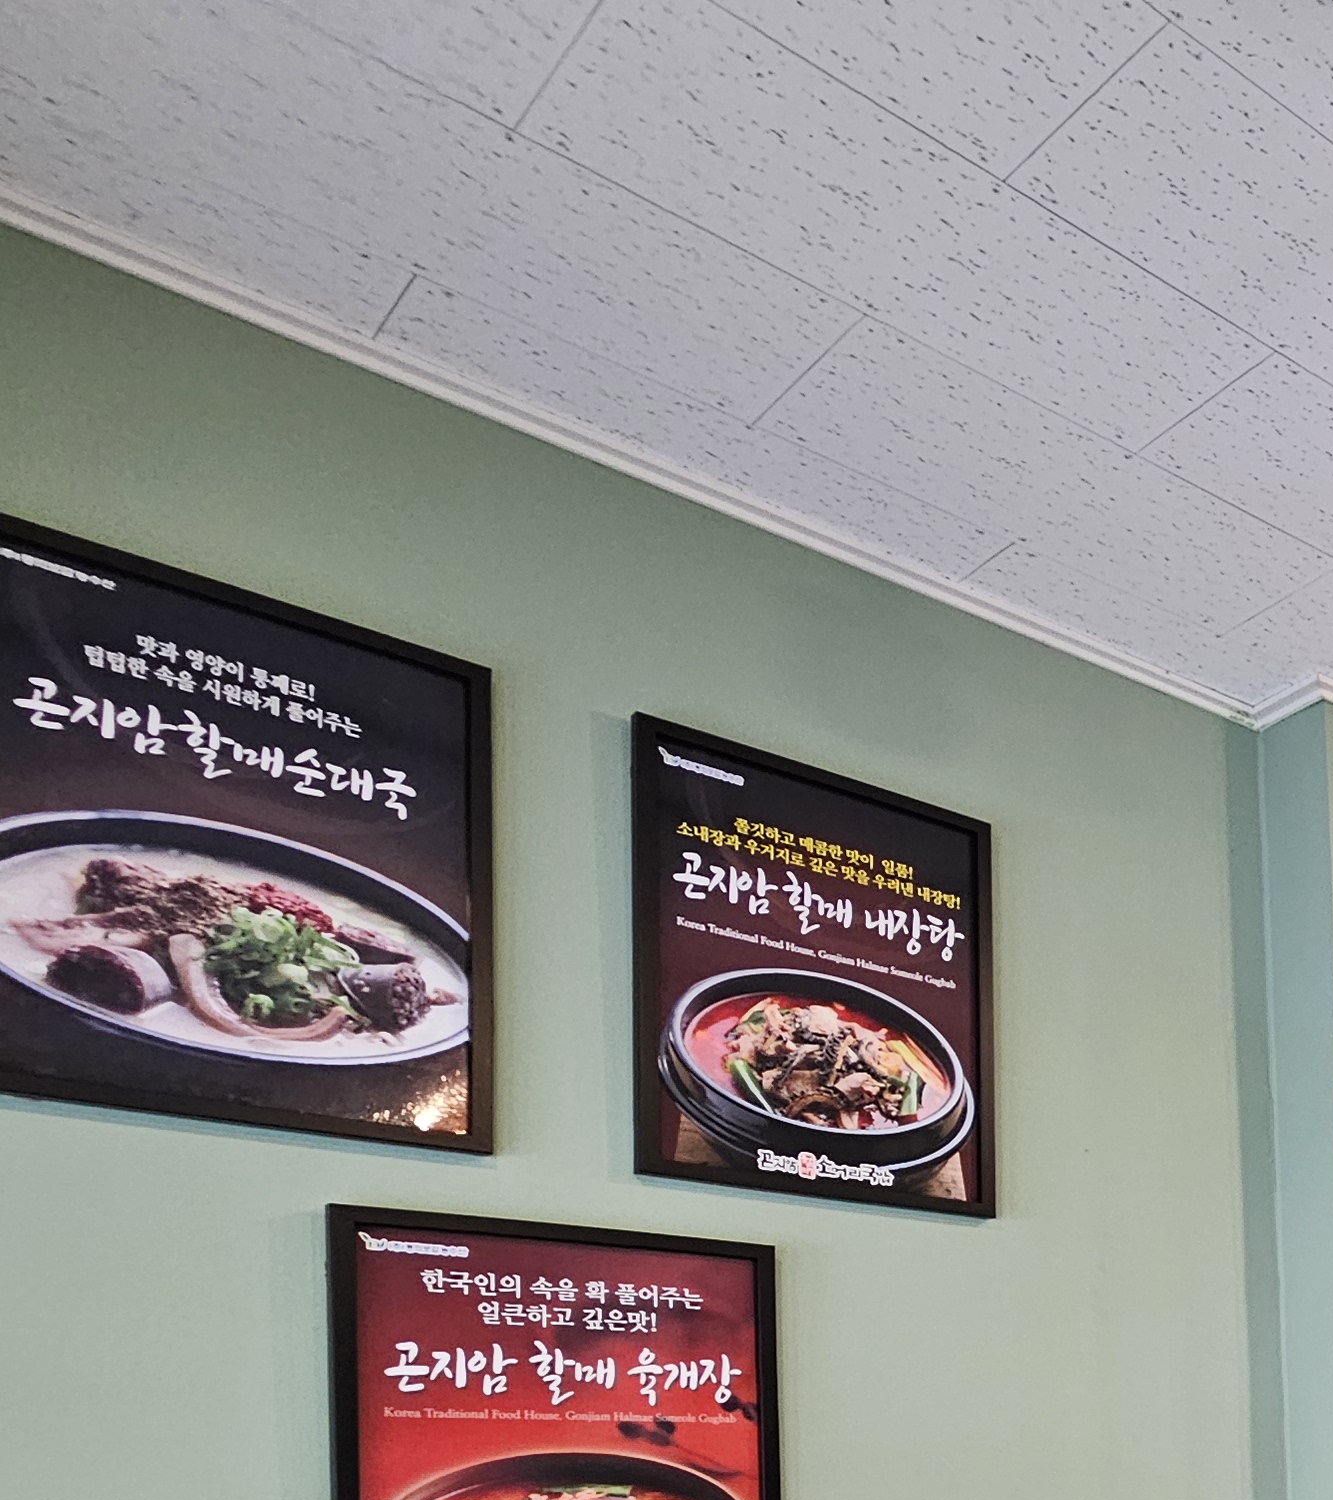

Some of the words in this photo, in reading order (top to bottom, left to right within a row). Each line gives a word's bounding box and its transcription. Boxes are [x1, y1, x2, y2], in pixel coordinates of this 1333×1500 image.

[83, 644, 150, 681] 텁텁한
[154, 664, 198, 693] 속을
[202, 679, 281, 717] 시원하게
[285, 701, 364, 739] 풀어주는
[135, 634, 180, 663] 맛과
[185, 648, 244, 683] 영양이
[250, 667, 316, 702] 통째로!
[676, 821, 742, 851] 소내장과
[744, 838, 806, 867] 우거지로
[809, 856, 839, 877] 깊은
[841, 865, 871, 886] 맛을
[873, 874, 914, 898] 우려낸
[917, 886, 962, 910] 내장탕!
[734, 817, 796, 846] 쫄깃하고
[799, 837, 844, 861] 매콤한
[846, 849, 874, 870] 맛이
[881, 859, 914, 880] 일품!
[672, 851, 779, 916] 곤지암
[781, 870, 853, 935] 할매
[864, 908, 966, 962] 내장탕
[676, 915, 706, 931] Korea
[707, 923, 759, 944] Traditional
[760, 935, 784, 949] Food
[420, 1268, 522, 1298] 한국인의
[529, 1276, 579, 1302] 속을
[585, 1281, 610, 1304] 확
[615, 1283, 704, 1310] 풀어주는
[477, 1301, 575, 1328] 얼큰하고
[384, 1340, 519, 1396] 곤지암
[529, 1339, 616, 1407] 할매
[627, 1347, 743, 1407] 육개장
[383, 1406, 422, 1419] Korea
[423, 1408, 489, 1420] Traditional
[491, 1409, 521, 1420] Food
